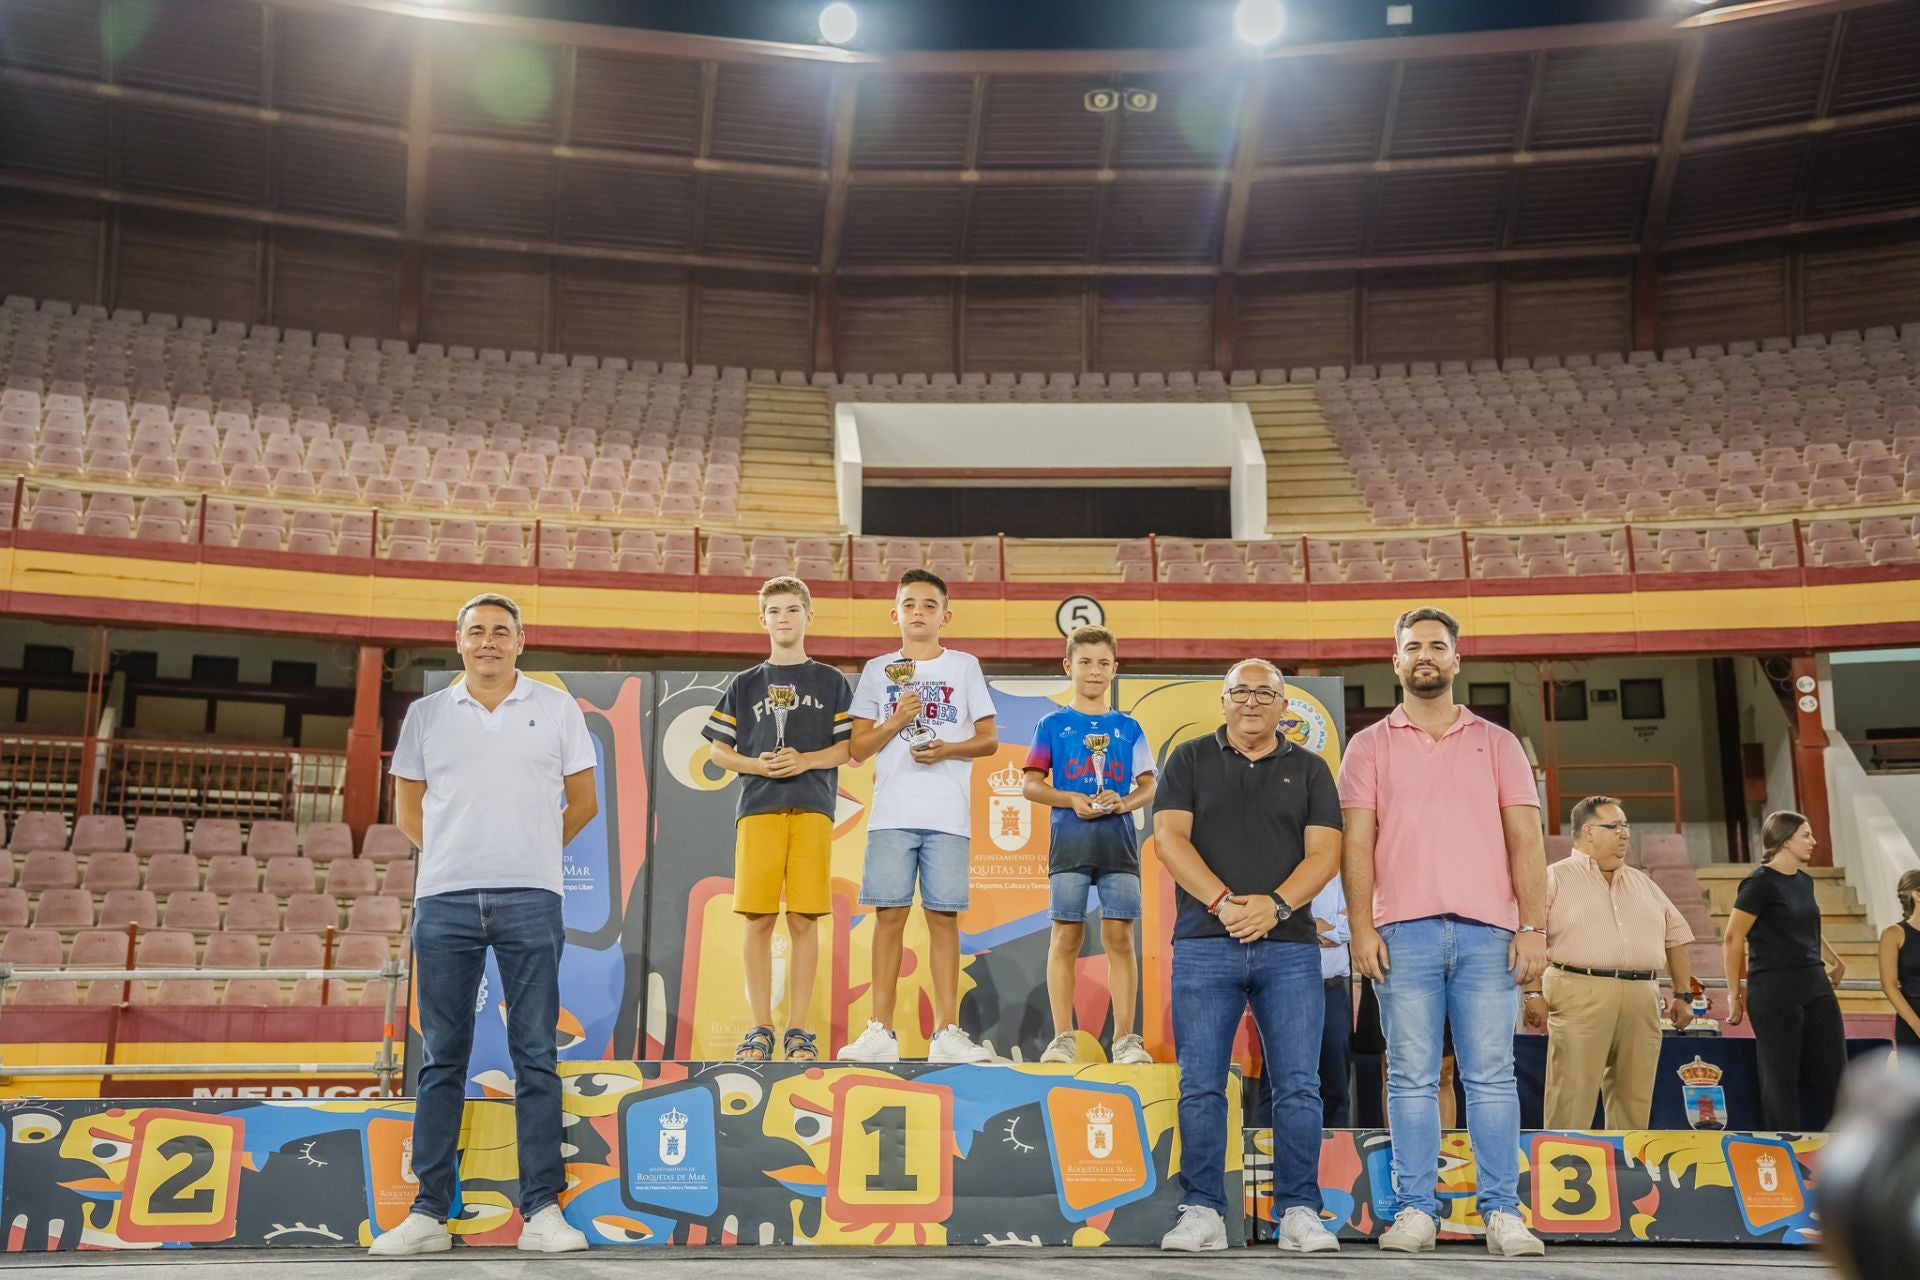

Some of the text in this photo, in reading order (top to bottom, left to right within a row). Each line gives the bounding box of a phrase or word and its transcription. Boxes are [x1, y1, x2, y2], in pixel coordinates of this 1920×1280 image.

[1071, 605, 1091, 631] 5
[974, 854, 1036, 862] AYUNTAMIENTO
[563, 864, 591, 876] MAR
[968, 865, 1015, 876] QUETAS
[1019, 865, 1033, 875] DE
[861, 1106, 918, 1192] 1
[147, 1135, 216, 1214] 2
[636, 1173, 675, 1182] ROQUETAS
[1550, 1154, 1597, 1216] 3
